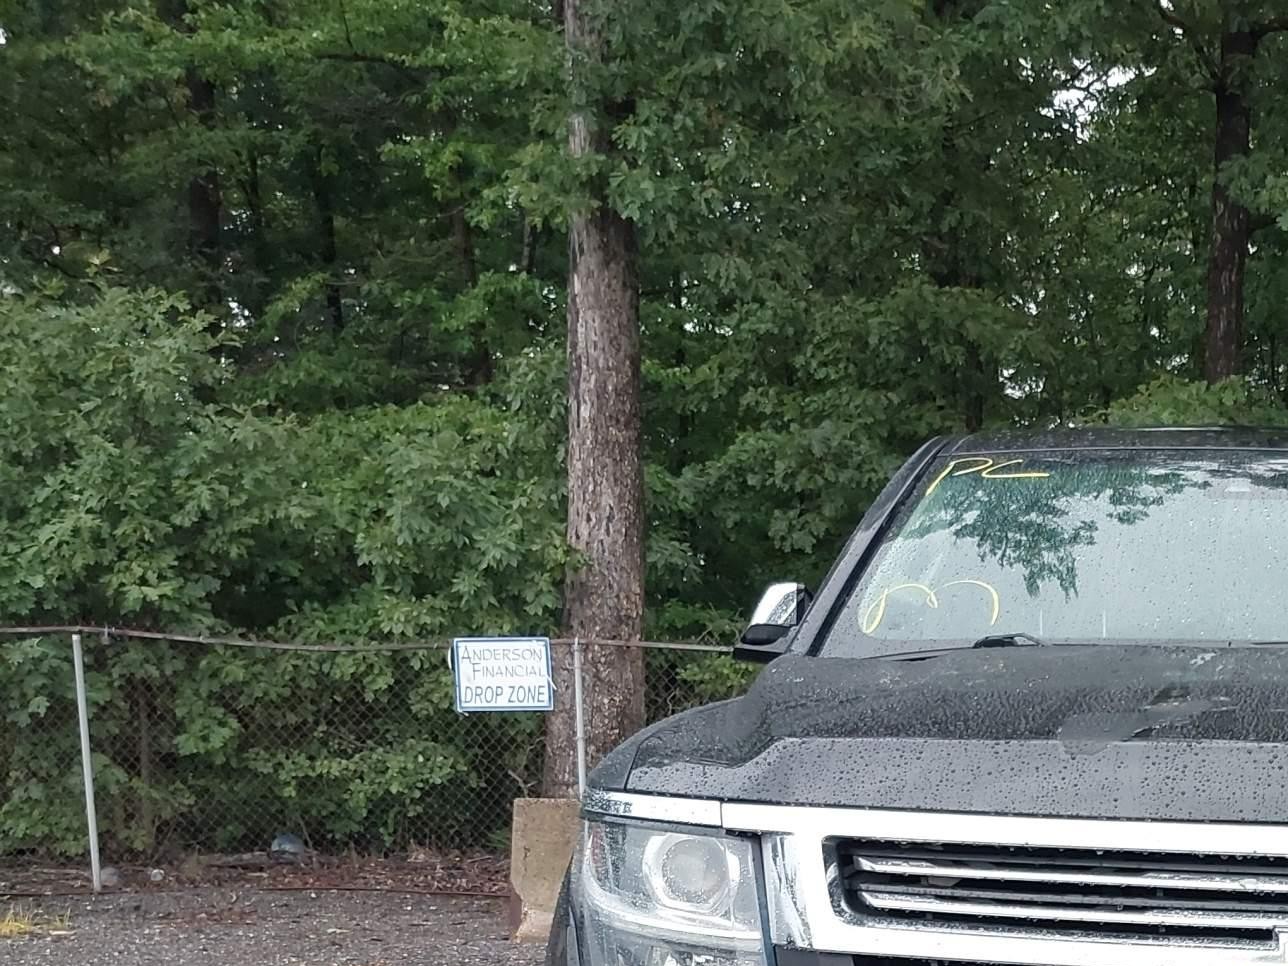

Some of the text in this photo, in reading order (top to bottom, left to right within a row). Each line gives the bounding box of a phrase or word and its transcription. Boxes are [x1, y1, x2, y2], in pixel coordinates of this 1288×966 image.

[461, 645, 543, 664] ANDERSON
[472, 662, 545, 680] FINANCIAL
[464, 685, 545, 704] DROP ZONE
